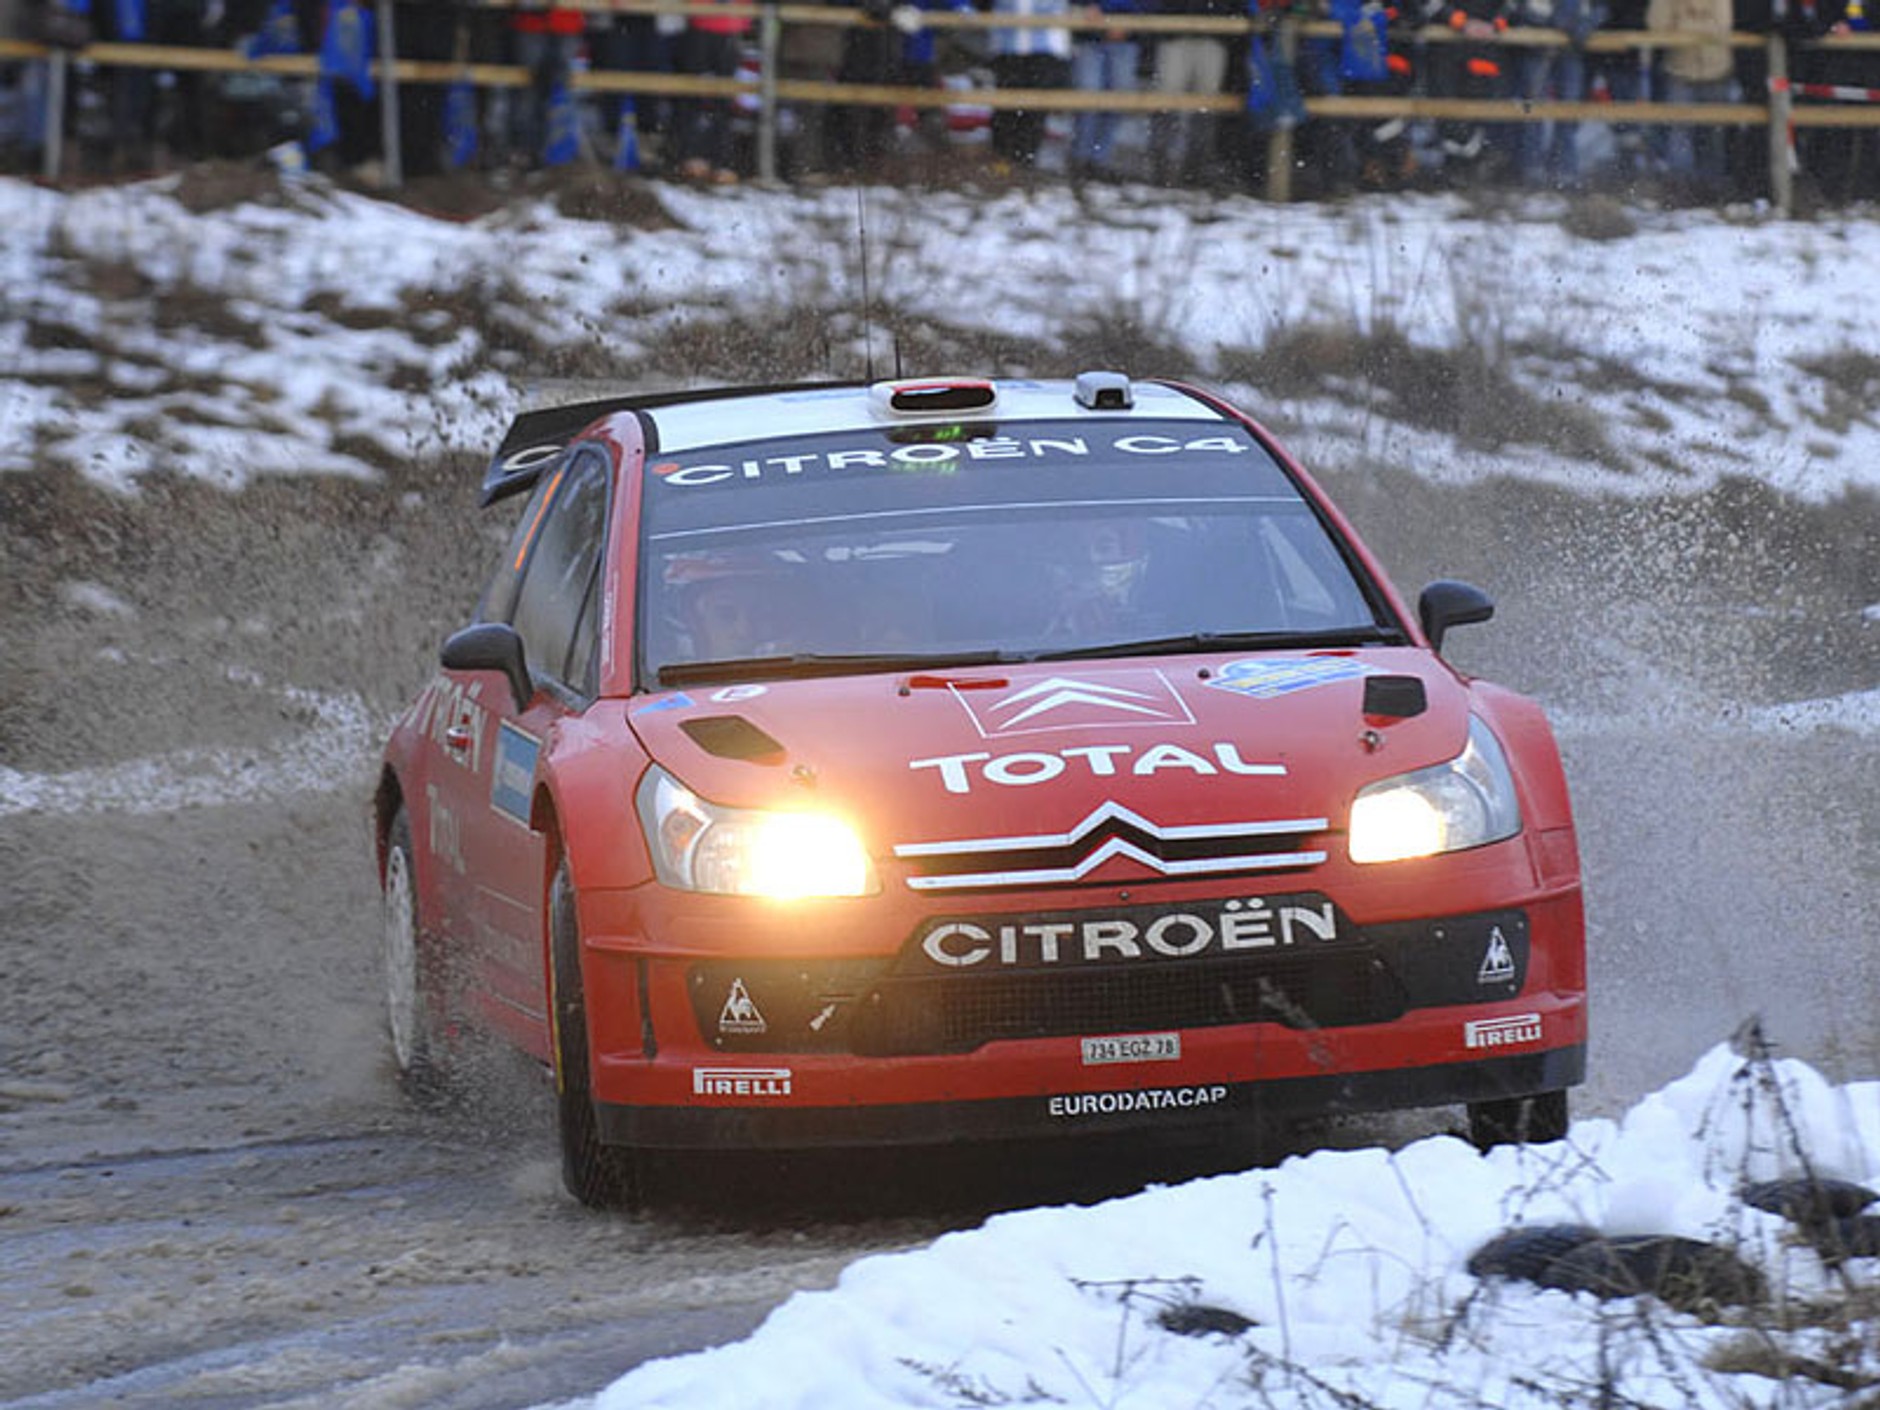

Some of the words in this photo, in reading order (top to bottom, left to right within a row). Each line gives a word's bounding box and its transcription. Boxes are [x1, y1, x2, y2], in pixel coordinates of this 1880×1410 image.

[663, 436, 1090, 486] CITROËN
[1112, 435, 1249, 454] C4
[909, 742, 1288, 794] TOTAL
[922, 896, 1337, 967] CITROËN
[1465, 1012, 1542, 1048] PIRELLI
[693, 1067, 792, 1095] PIRELLI
[1049, 1086, 1227, 1115] EURODATACAP
